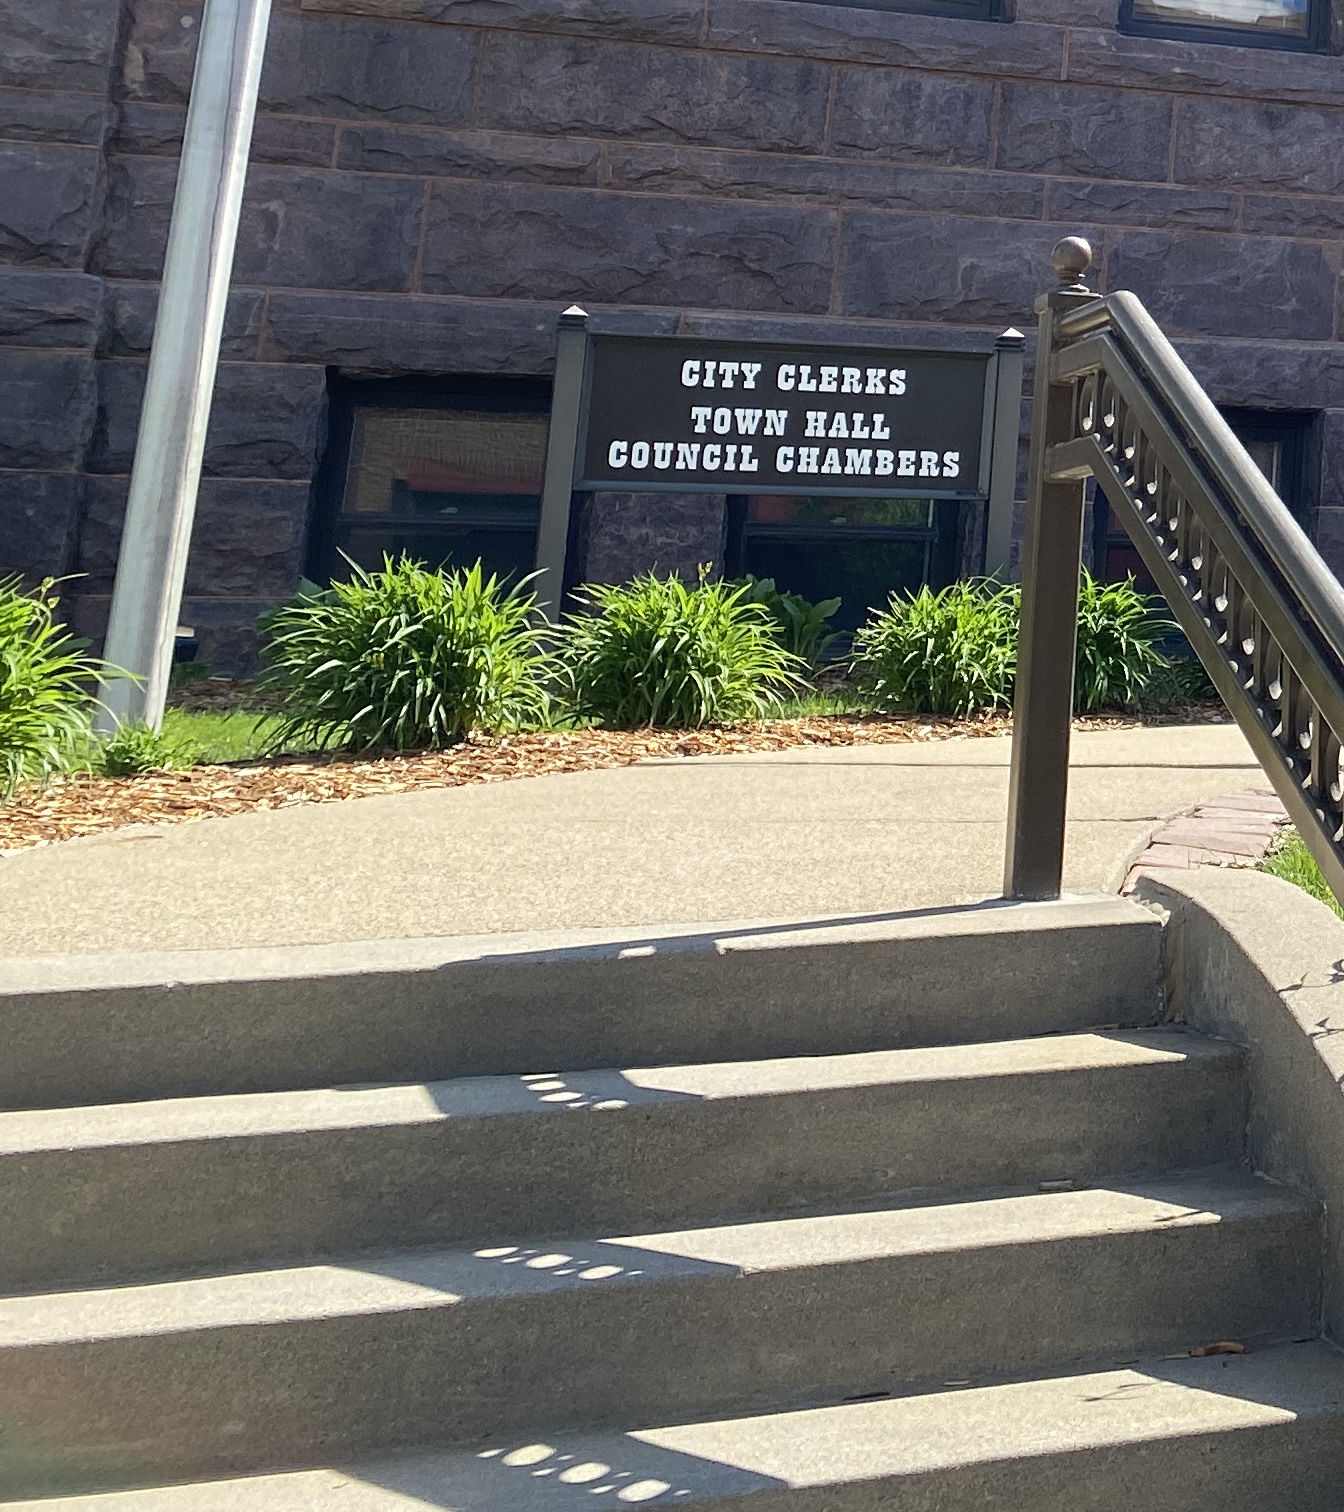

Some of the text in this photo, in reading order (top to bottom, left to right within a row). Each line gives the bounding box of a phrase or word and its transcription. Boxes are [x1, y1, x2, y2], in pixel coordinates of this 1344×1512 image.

[681, 359, 907, 396] CITY CLERKS
[690, 406, 891, 440] TOWN HALL
[608, 440, 960, 478] COUNCIL CHAMBERS
